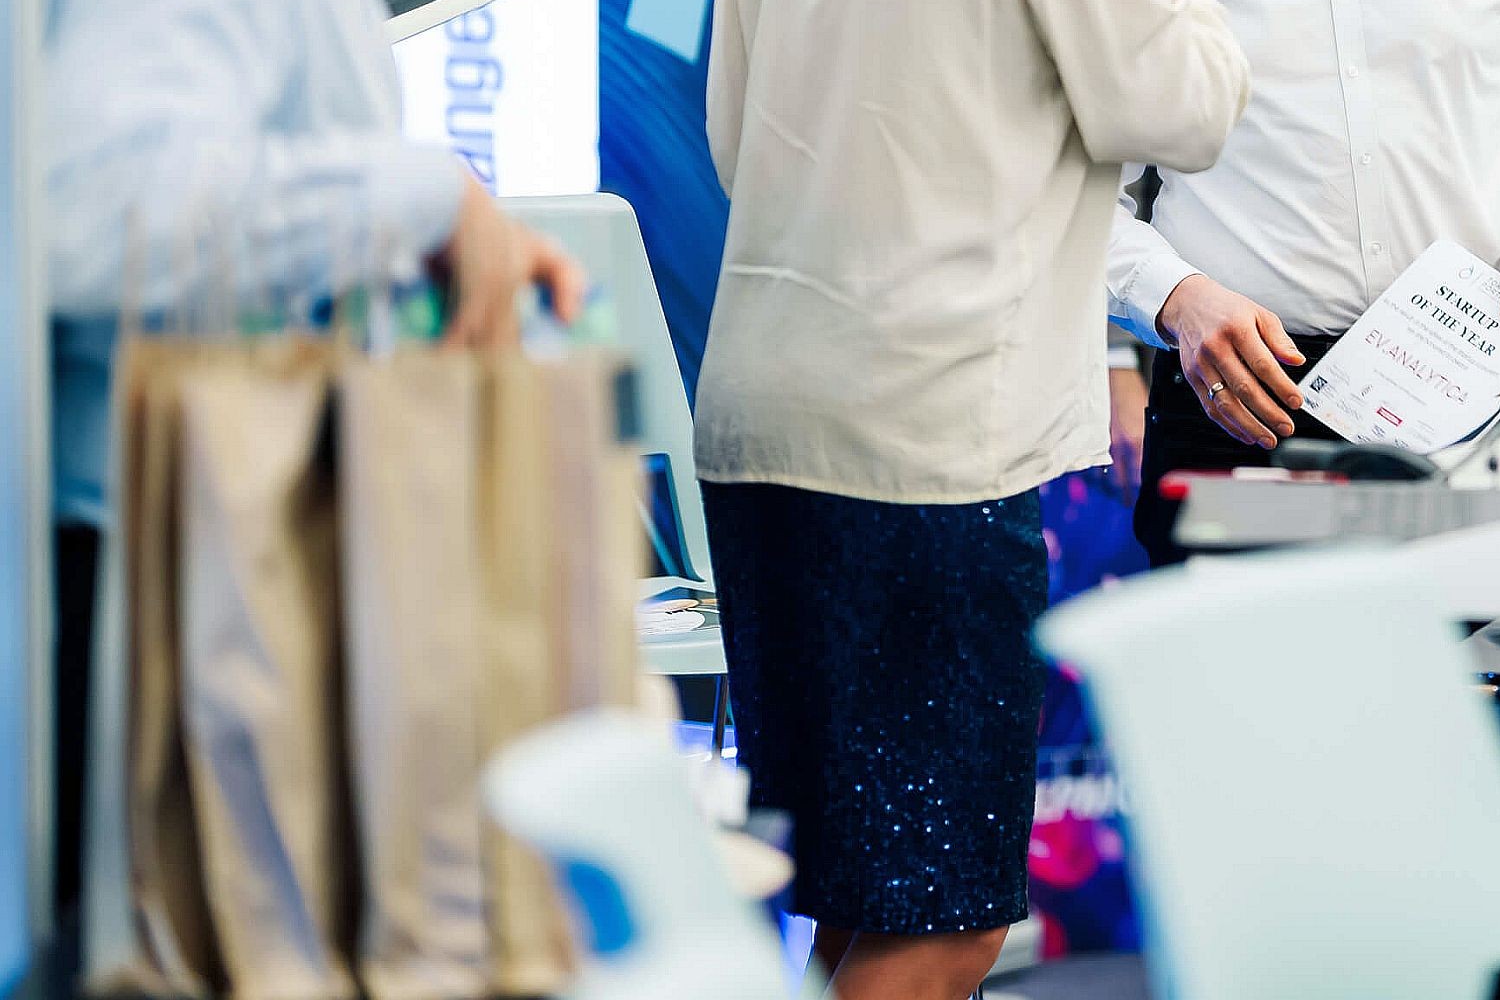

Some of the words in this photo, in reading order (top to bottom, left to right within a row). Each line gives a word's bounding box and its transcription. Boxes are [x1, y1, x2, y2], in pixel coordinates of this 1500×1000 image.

[1411, 294, 1432, 311] OF
[1431, 306, 1461, 331] THE
[1459, 326, 1498, 357] YEAR
[1435, 284, 1499, 332] STARTUP
